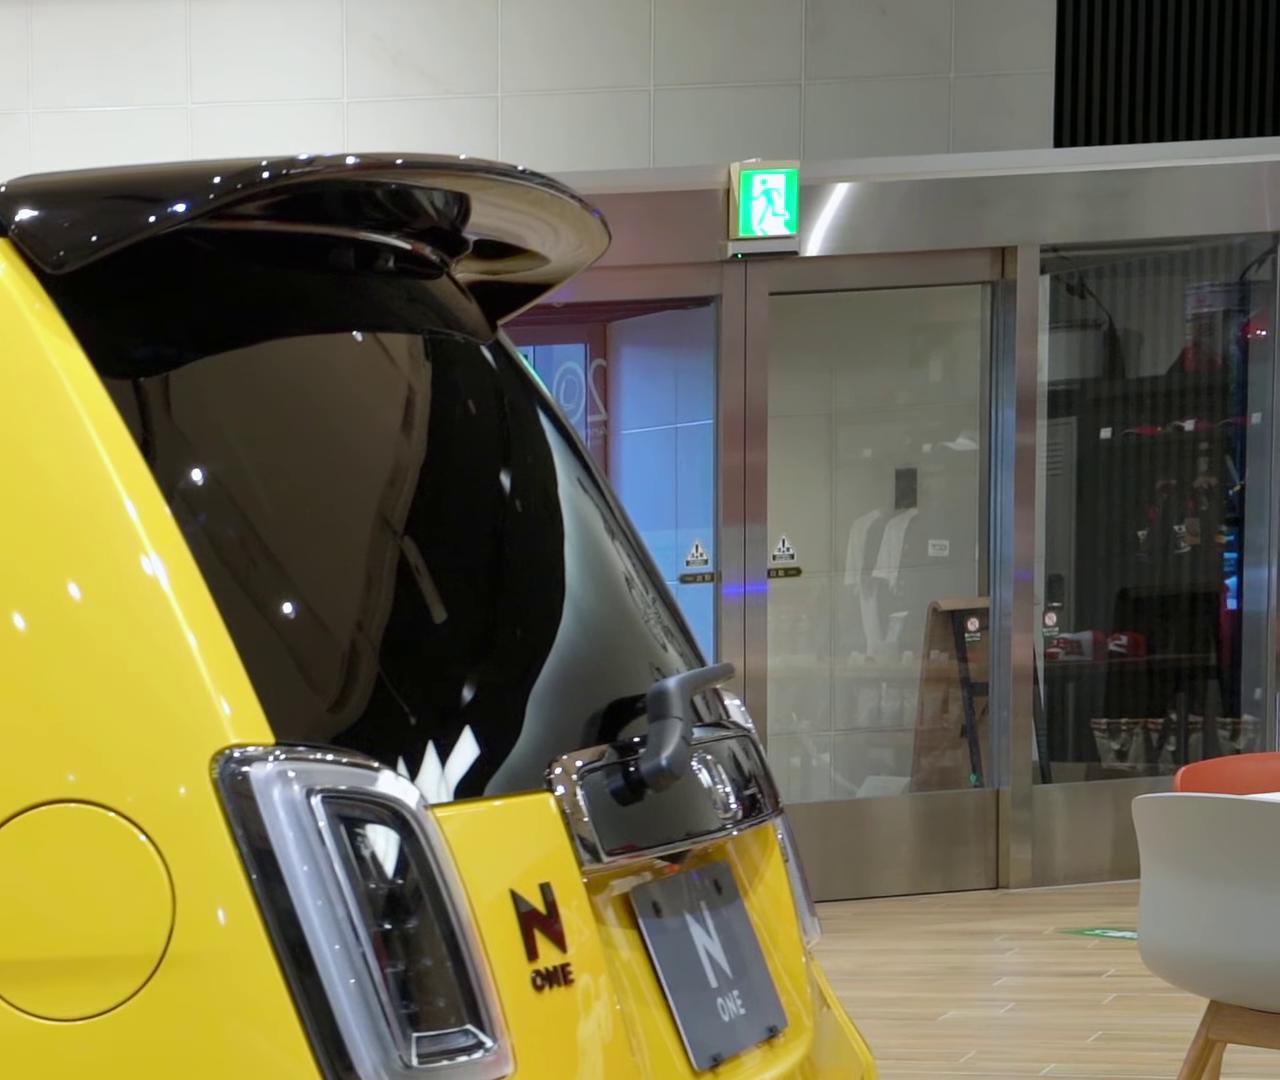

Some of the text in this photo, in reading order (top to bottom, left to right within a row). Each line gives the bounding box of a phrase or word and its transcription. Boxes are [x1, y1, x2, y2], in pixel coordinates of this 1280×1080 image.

[509, 881, 568, 963] N
[683, 901, 733, 988] N
[530, 962, 575, 993] ONE
[716, 989, 746, 1022] ONE
